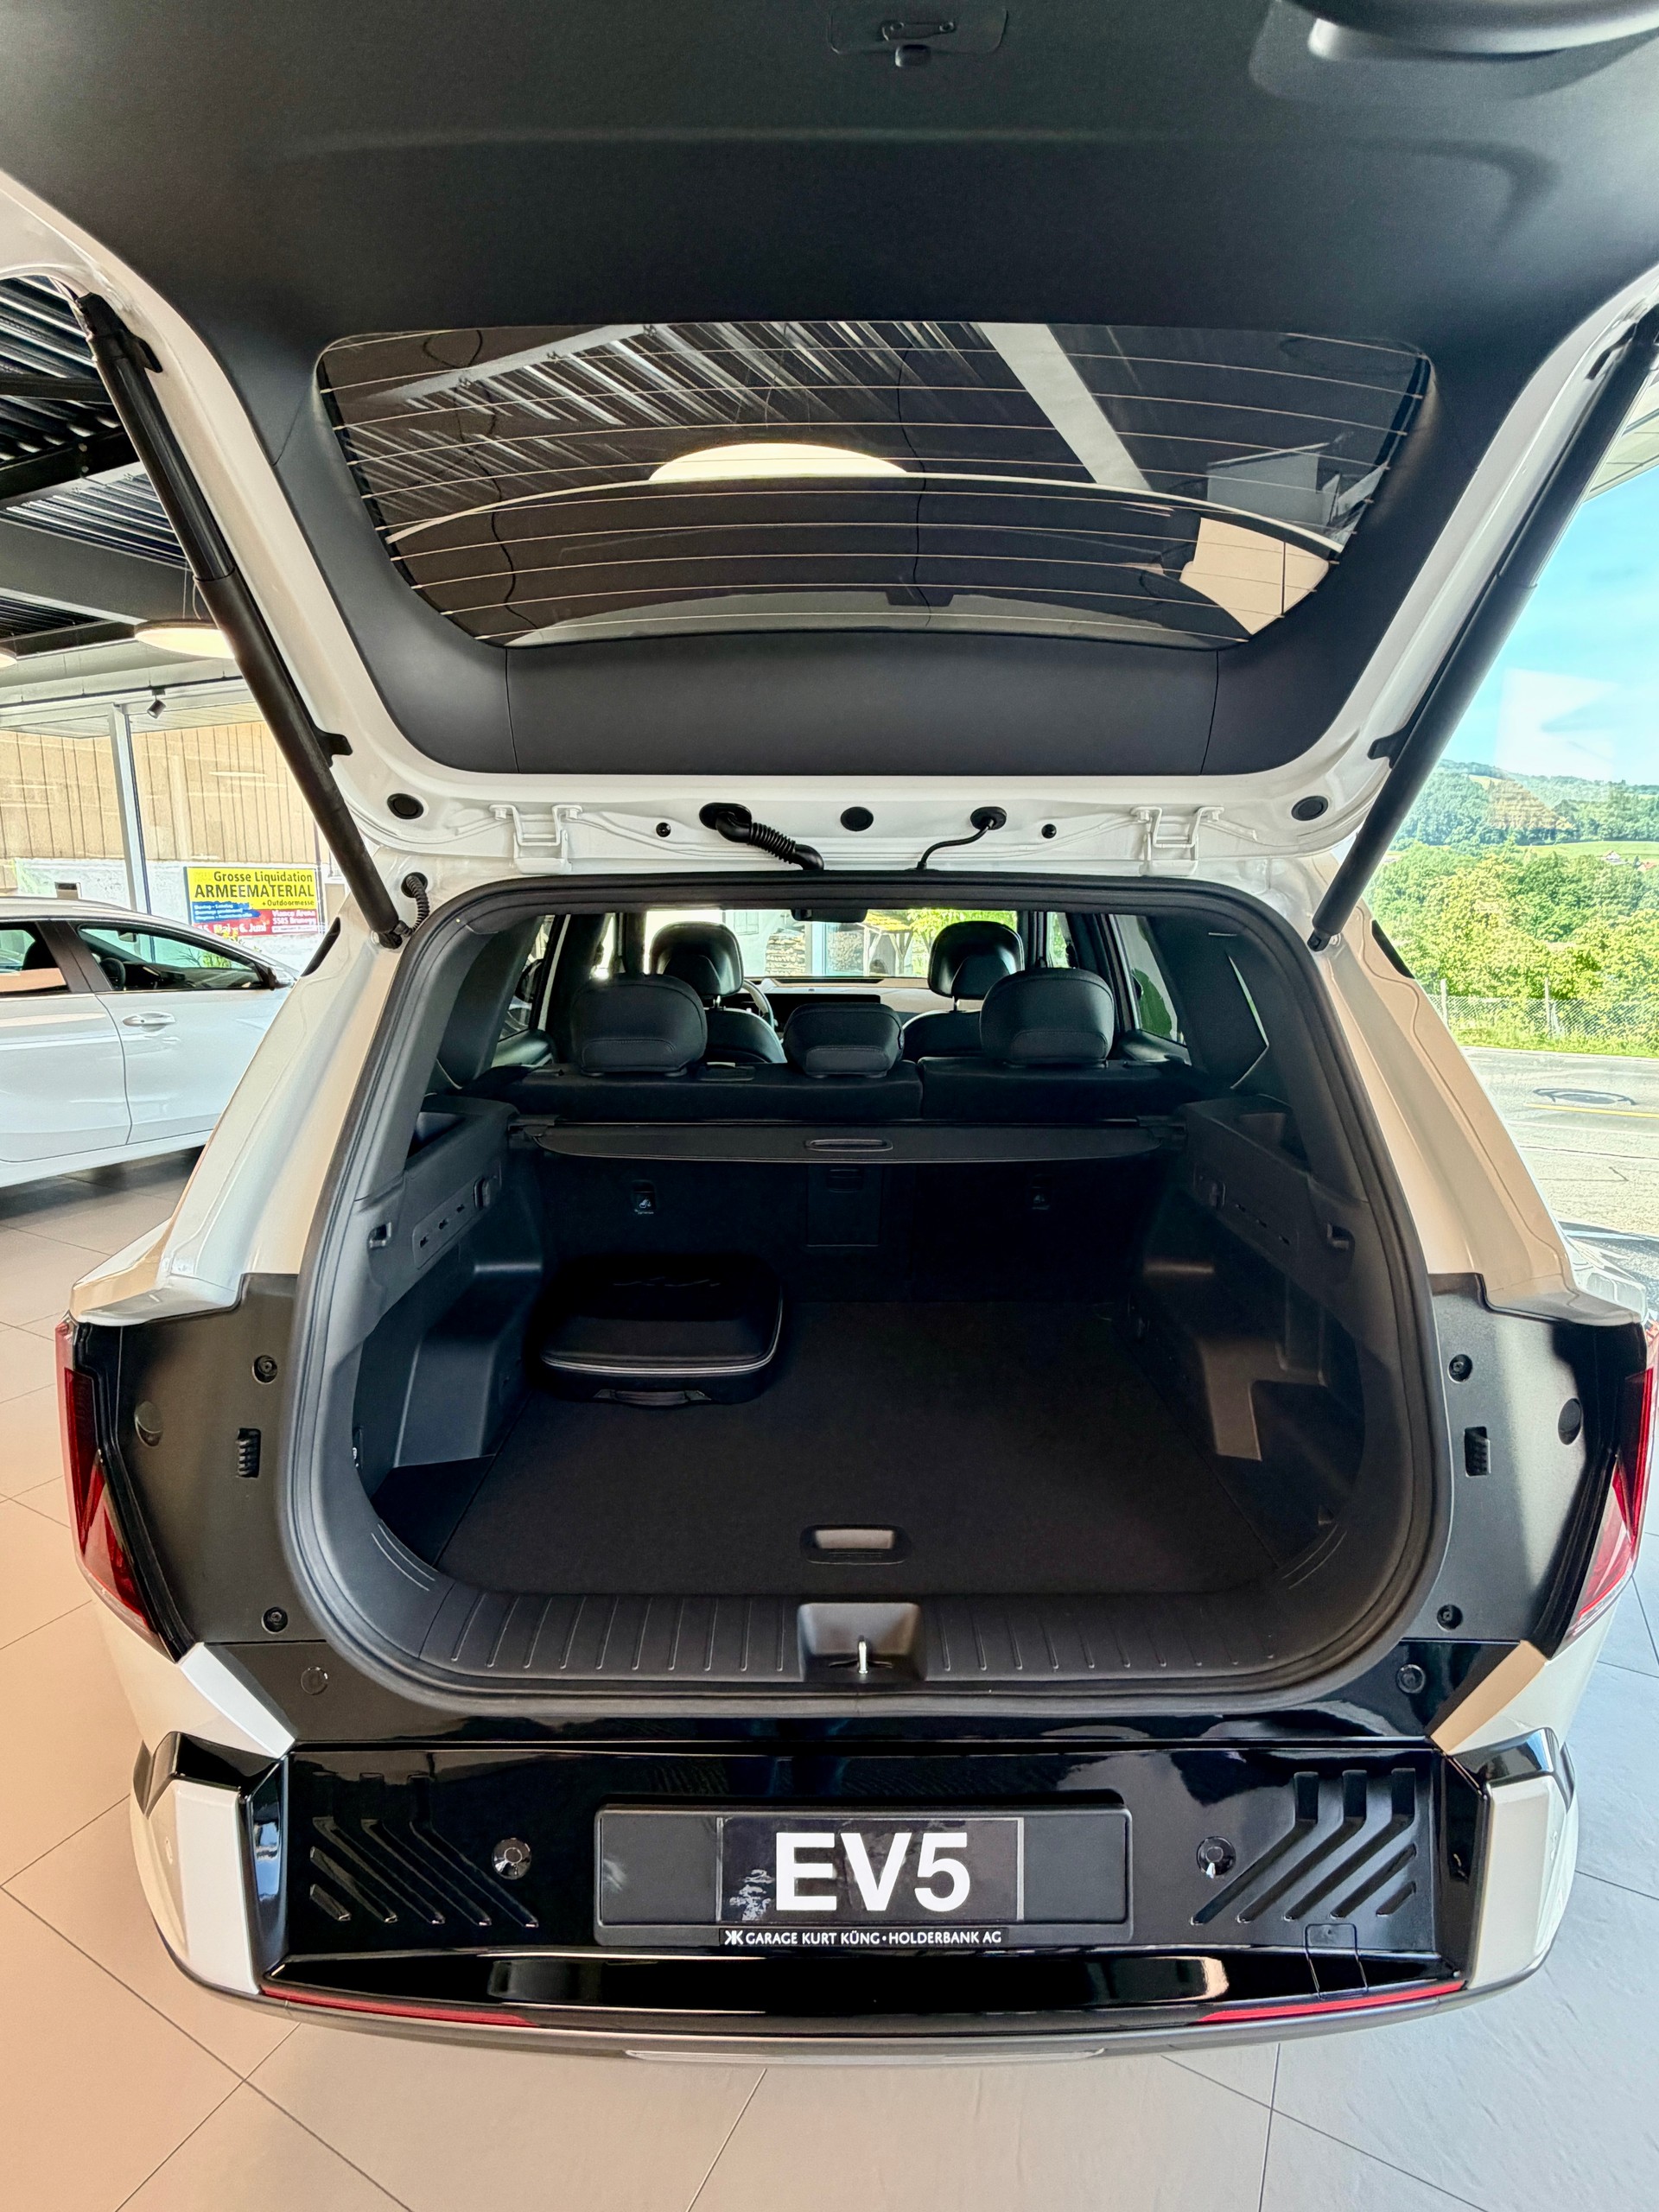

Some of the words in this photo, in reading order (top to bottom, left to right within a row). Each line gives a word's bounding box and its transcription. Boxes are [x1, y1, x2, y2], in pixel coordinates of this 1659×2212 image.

[213, 871, 251, 882] Grosse
[254, 871, 313, 886] Liquidation
[194, 884, 315, 898] ARMEEMATERIAL
[776, 1832, 970, 1911] EV5
[746, 1932, 798, 1945] GARAGE
[802, 1932, 836, 1945] KURT
[982, 1930, 1001, 1943] AG
